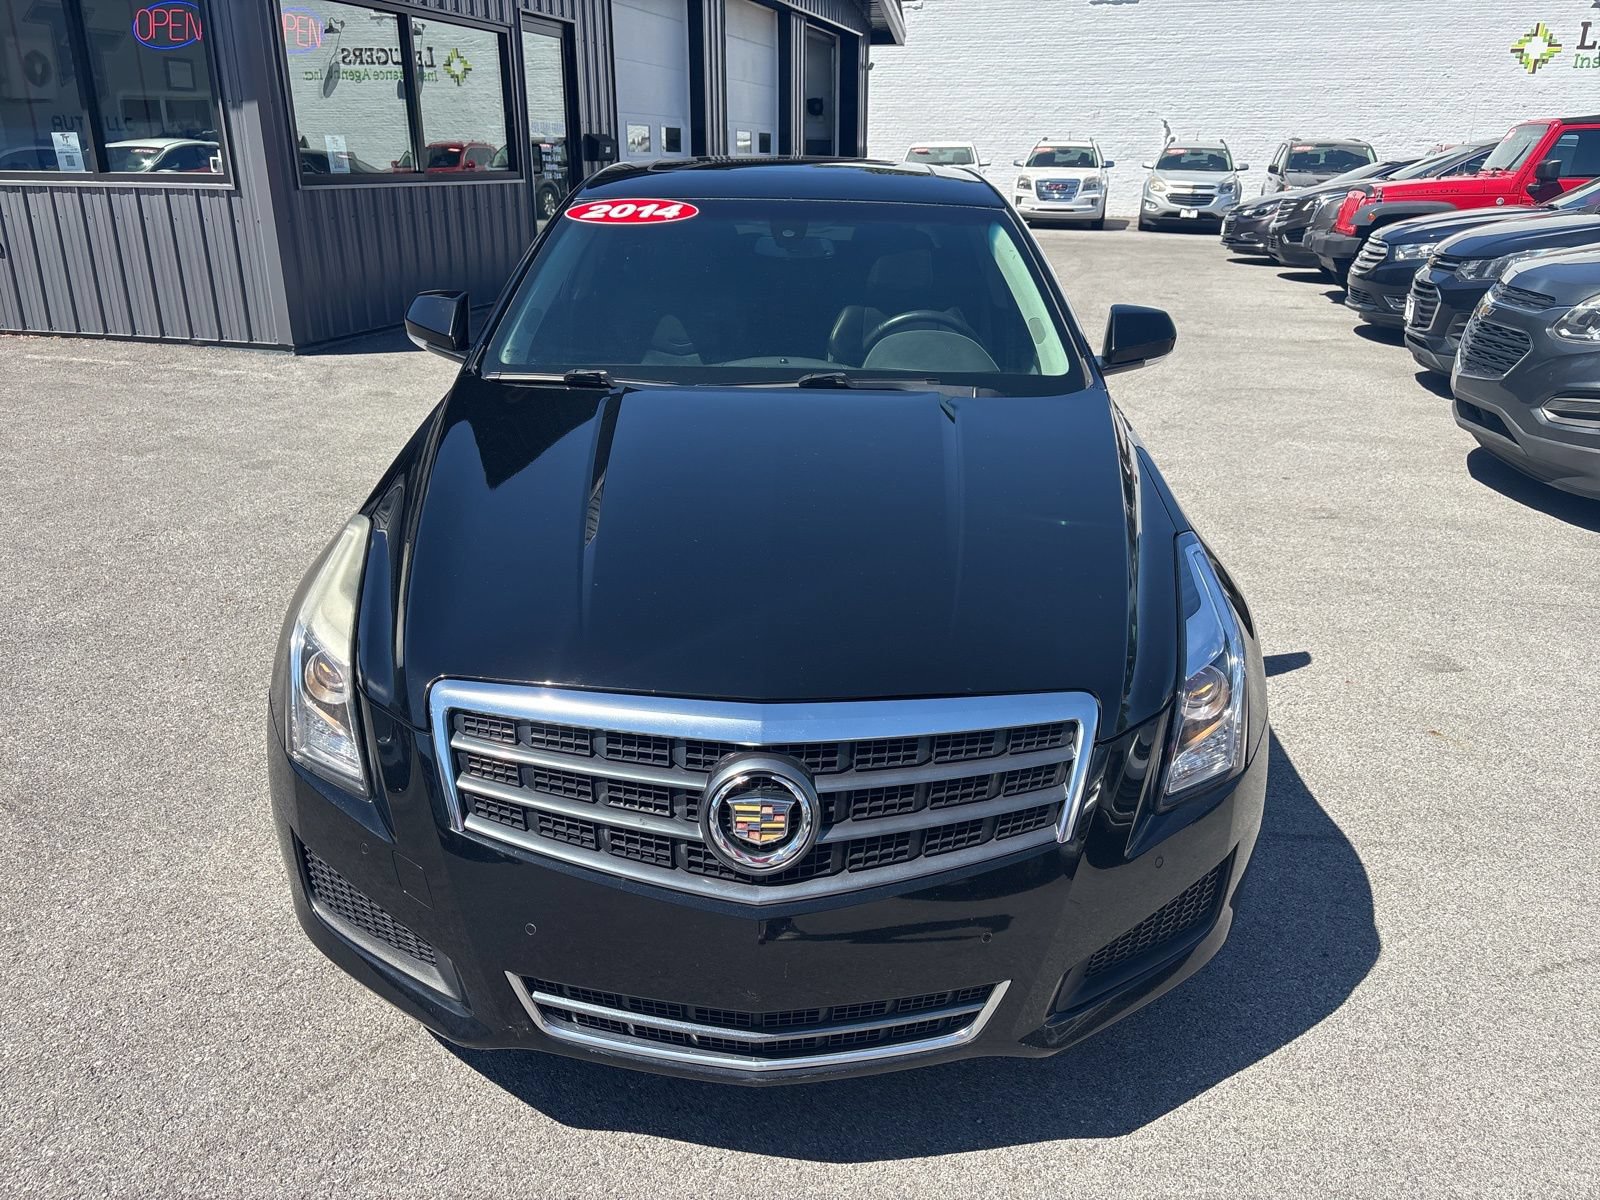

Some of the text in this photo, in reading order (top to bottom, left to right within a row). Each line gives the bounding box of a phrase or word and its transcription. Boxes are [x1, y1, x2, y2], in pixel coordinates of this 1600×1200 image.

[136, 8, 203, 41] OPEN
[283, 13, 321, 48] PEN
[579, 203, 684, 219] 2014
